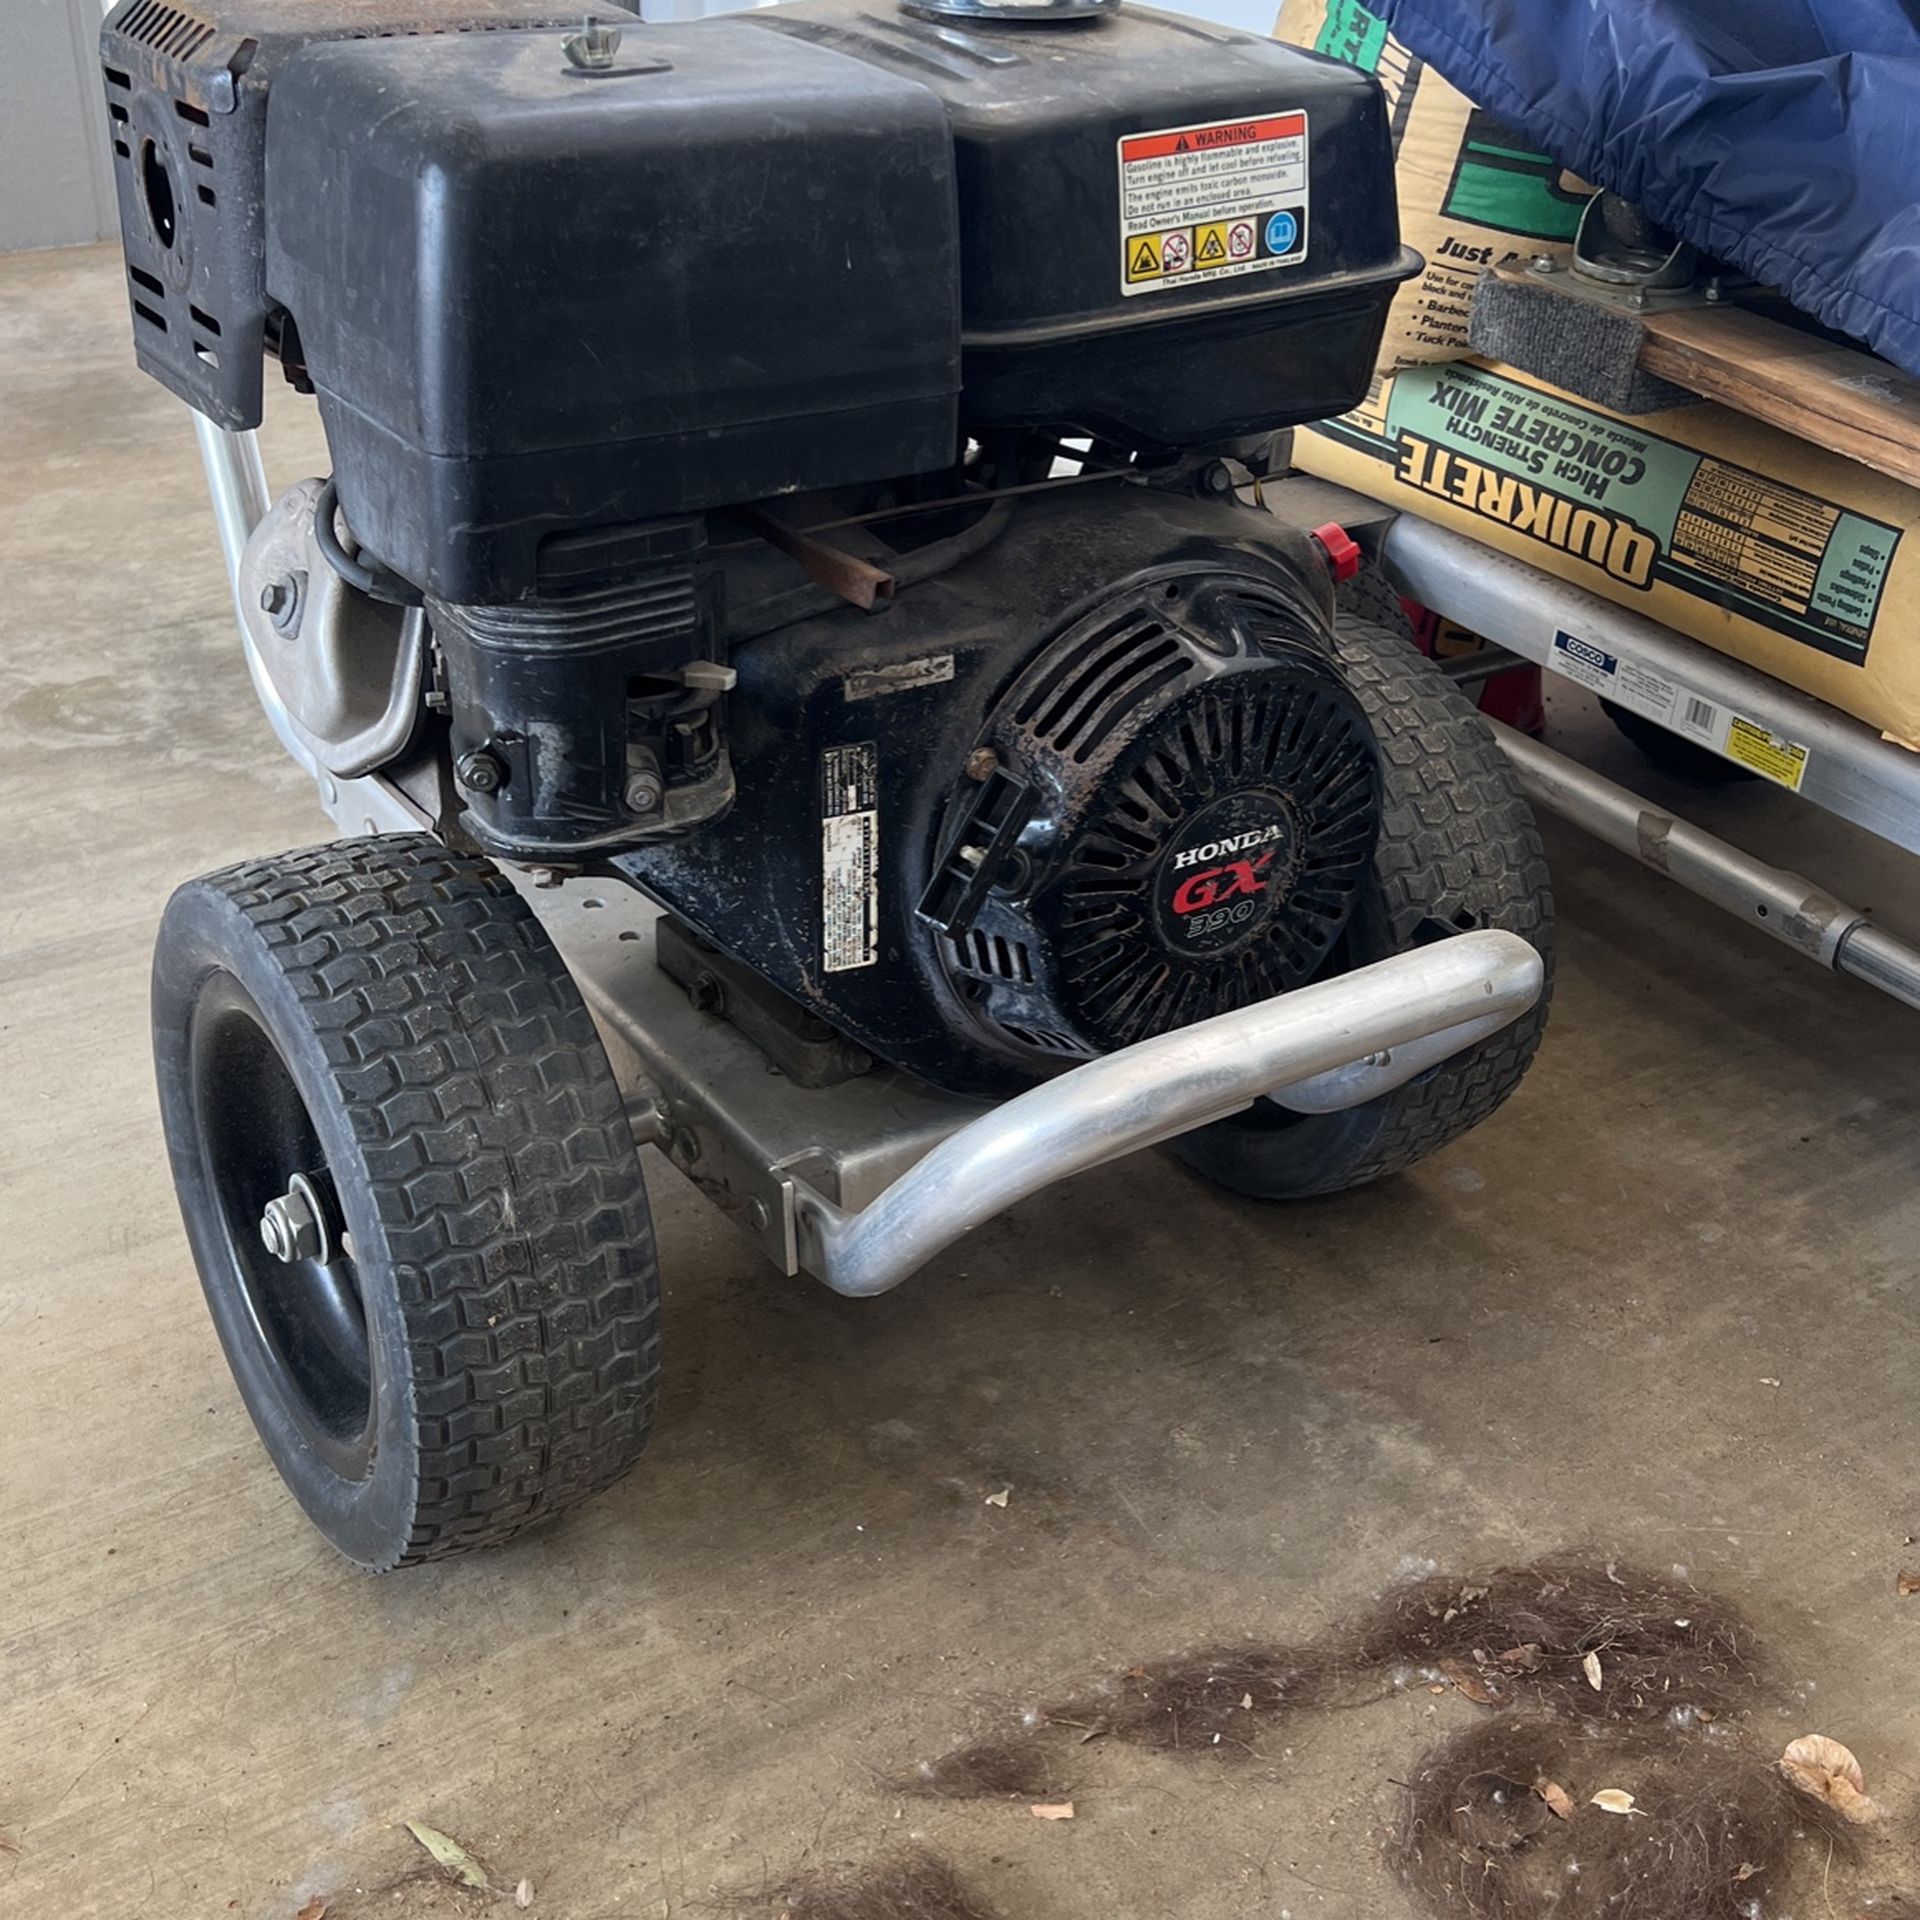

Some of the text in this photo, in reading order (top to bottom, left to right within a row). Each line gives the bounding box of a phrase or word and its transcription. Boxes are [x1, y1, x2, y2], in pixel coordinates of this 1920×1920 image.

[1195, 126, 1256, 146] WARNING
[1127, 139, 1297, 172] Gasoline is highly flammable and explosive.
[1128, 149, 1301, 185] Turn engine off and let cool before refueling.
[1128, 169, 1287, 202] The engine emits toxic carbon monoxide.
[1128, 186, 1250, 214] Do not run in an enclosed area.
[1128, 199, 1273, 230] Read Owner's Manual before operation.
[1435, 236, 1493, 265] Just
[1422, 282, 1446, 295] block
[1448, 289, 1467, 300] and
[1426, 271, 1444, 282] Use
[1446, 276, 1459, 286] for
[1427, 299, 1470, 318] Barbec
[1420, 315, 1469, 334] Planters
[1416, 331, 1472, 349] Tuck Poi
[1444, 369, 1648, 454] Mezcla de Concreto de Alta Resistencia
[1428, 382, 1647, 486] CONCRETE MIX
[1400, 435, 1656, 587] QUIKRETE
[1830, 582, 1866, 602] Sidewalks
[1840, 569, 1869, 589] Footings
[1817, 592, 1863, 617] Setting Posts
[1568, 640, 1603, 664] COSCO
[1173, 824, 1284, 870] HONDA
[1172, 850, 1277, 914] GX
[1186, 899, 1255, 938] 390
